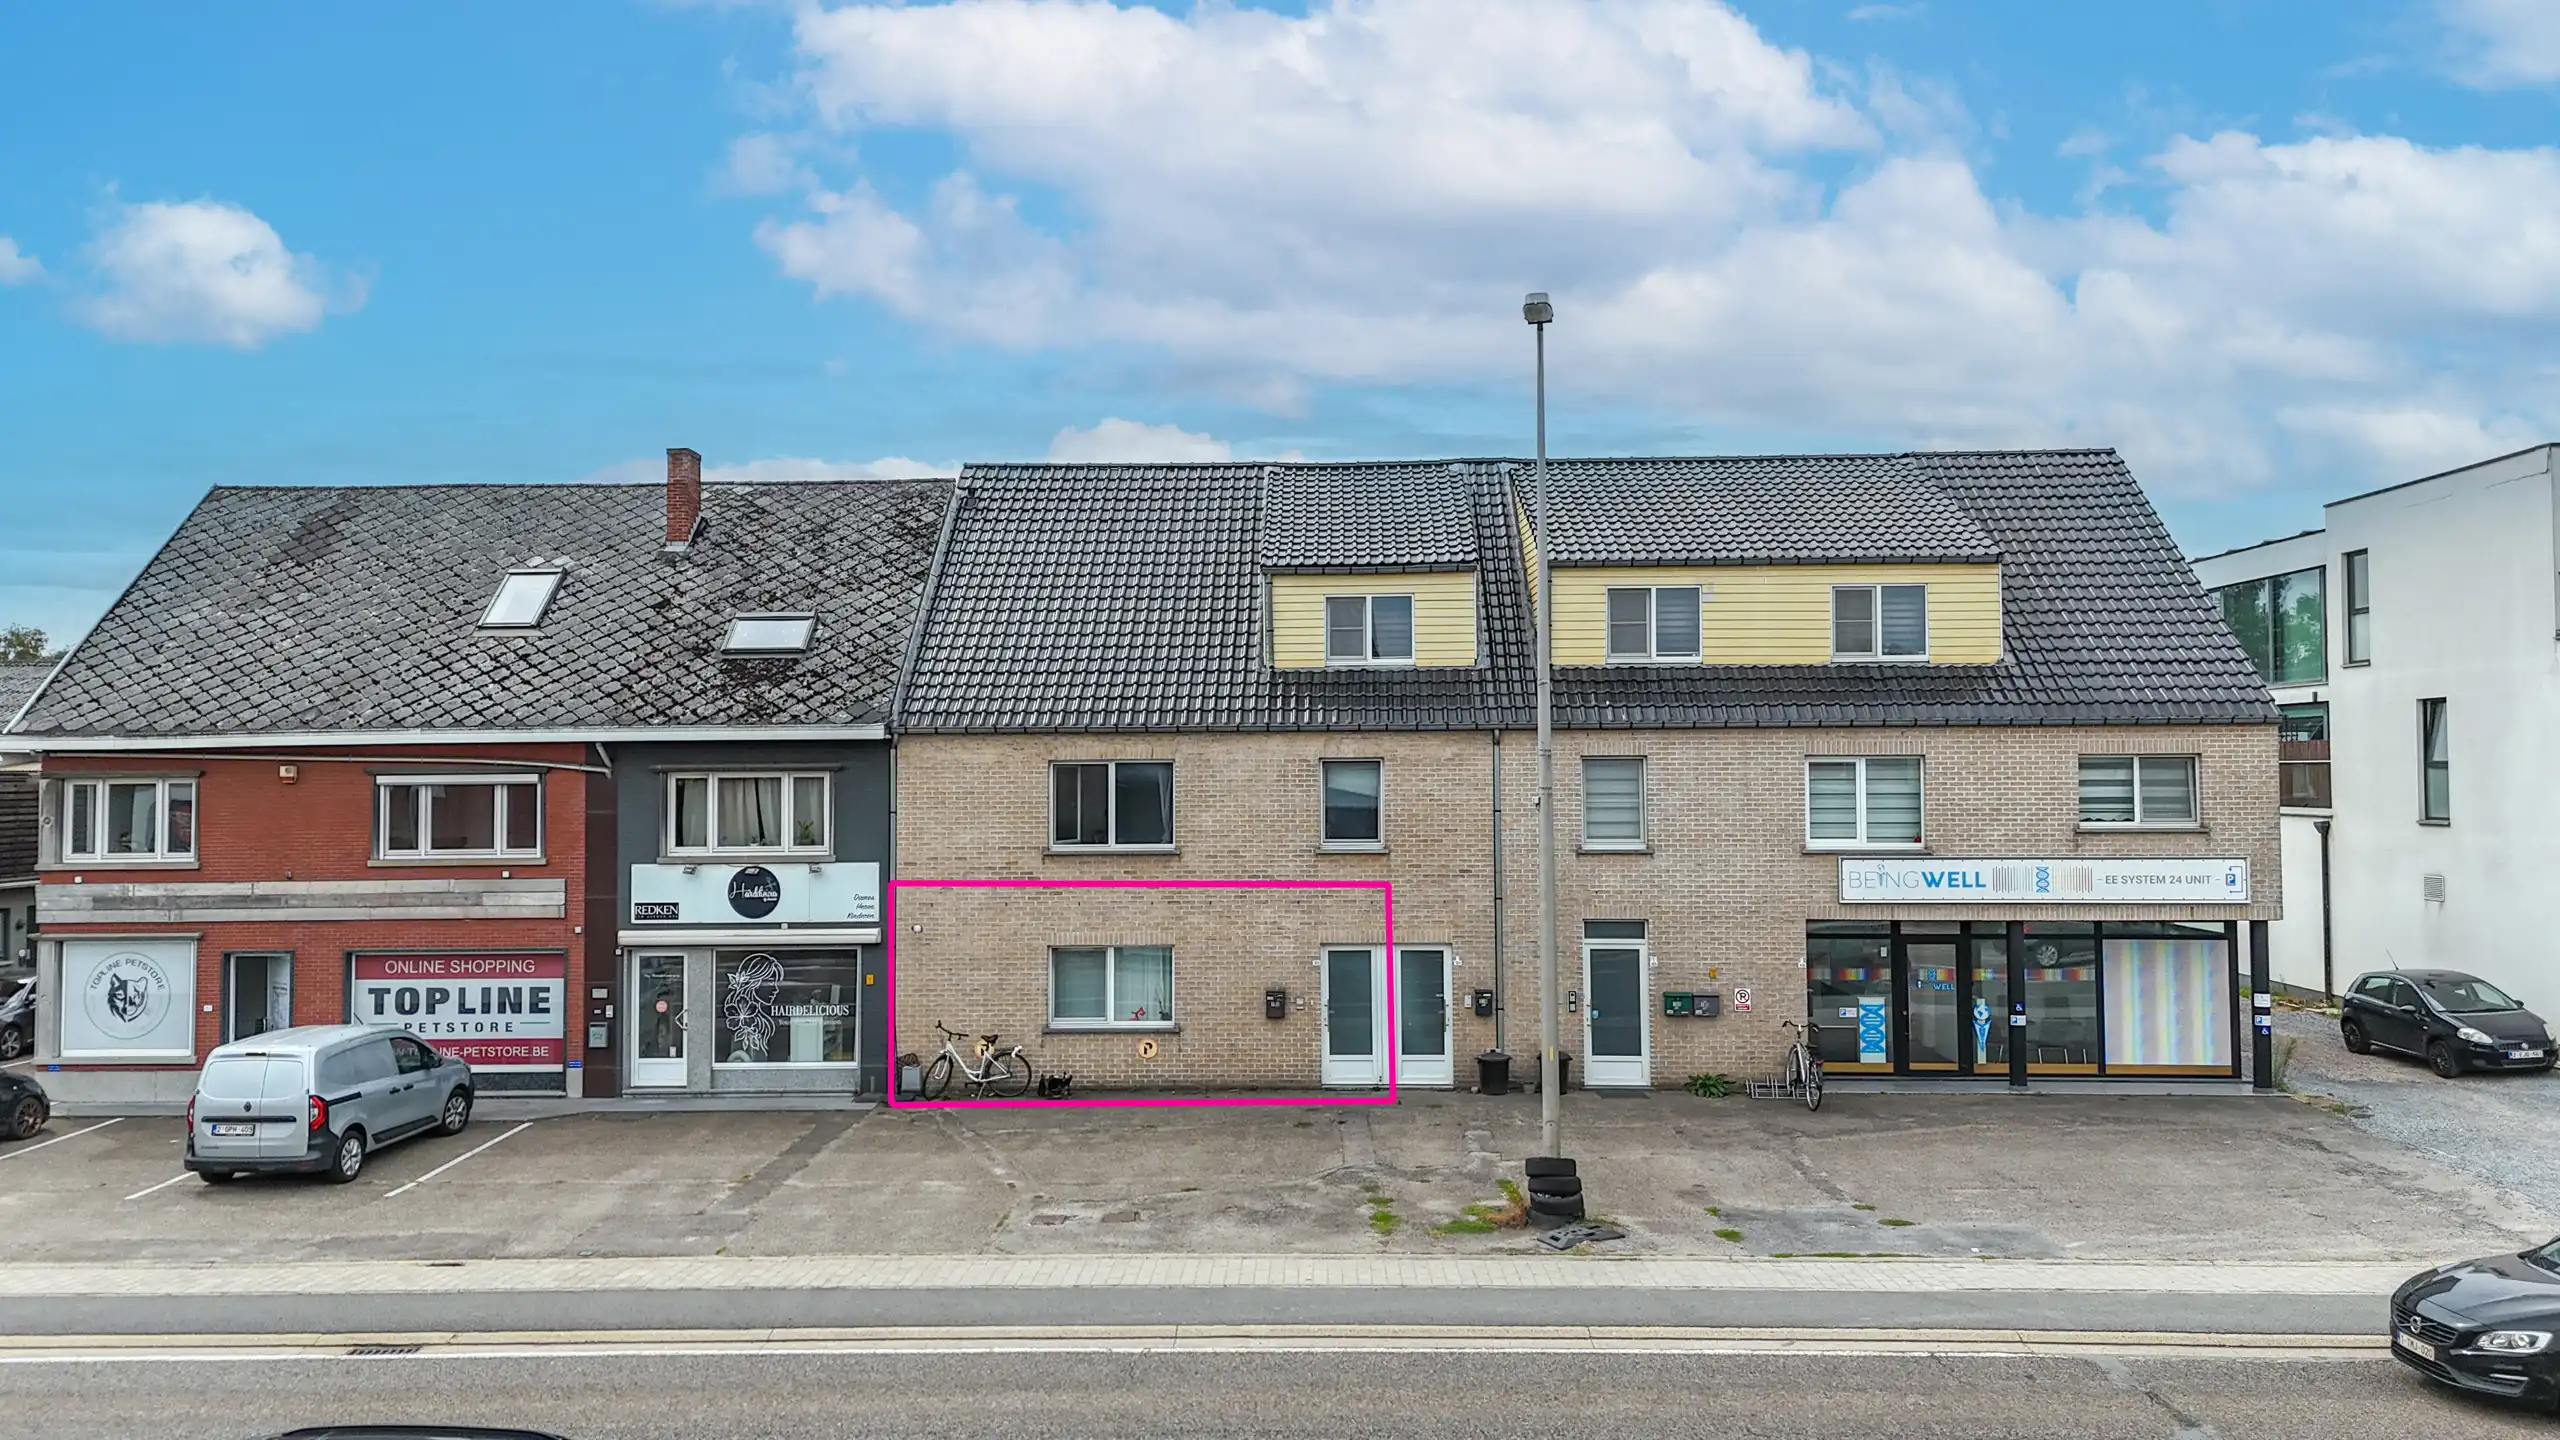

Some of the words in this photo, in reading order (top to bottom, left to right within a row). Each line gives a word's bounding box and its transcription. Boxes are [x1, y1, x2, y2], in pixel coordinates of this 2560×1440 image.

[2105, 875, 2118, 885] EE
[2121, 875, 2166, 885] SYSTEM
[2169, 875, 2182, 885] 24
[2185, 874, 2212, 885] UNIT
[635, 905, 678, 915] REDKEN
[384, 960, 445, 974] ONLINE
[450, 959, 536, 973] SHOPPING
[90, 960, 122, 990] TOPLINE
[125, 958, 165, 991] PETSTORE
[367, 986, 551, 1016] TOPLINE
[771, 1005, 850, 1017] HAIRDELICIOUS
[404, 1021, 514, 1033] PETSTORE
